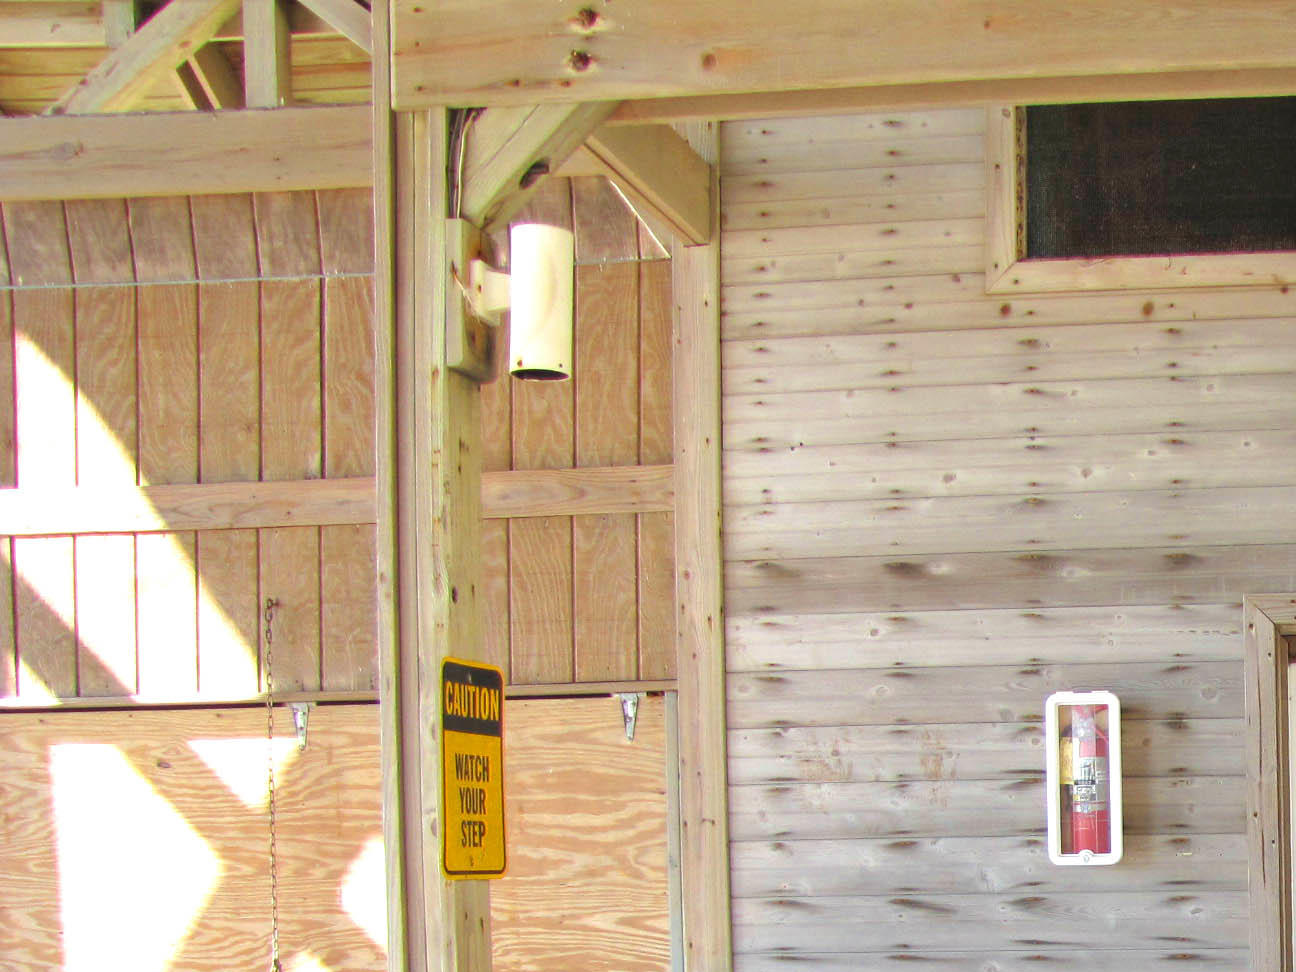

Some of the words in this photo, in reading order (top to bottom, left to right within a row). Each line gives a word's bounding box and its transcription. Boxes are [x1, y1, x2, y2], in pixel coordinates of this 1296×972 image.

[445, 681, 500, 721] CAUTION
[455, 752, 490, 782] WATCH
[459, 787, 486, 815] YOUR
[461, 820, 486, 848] STEP
